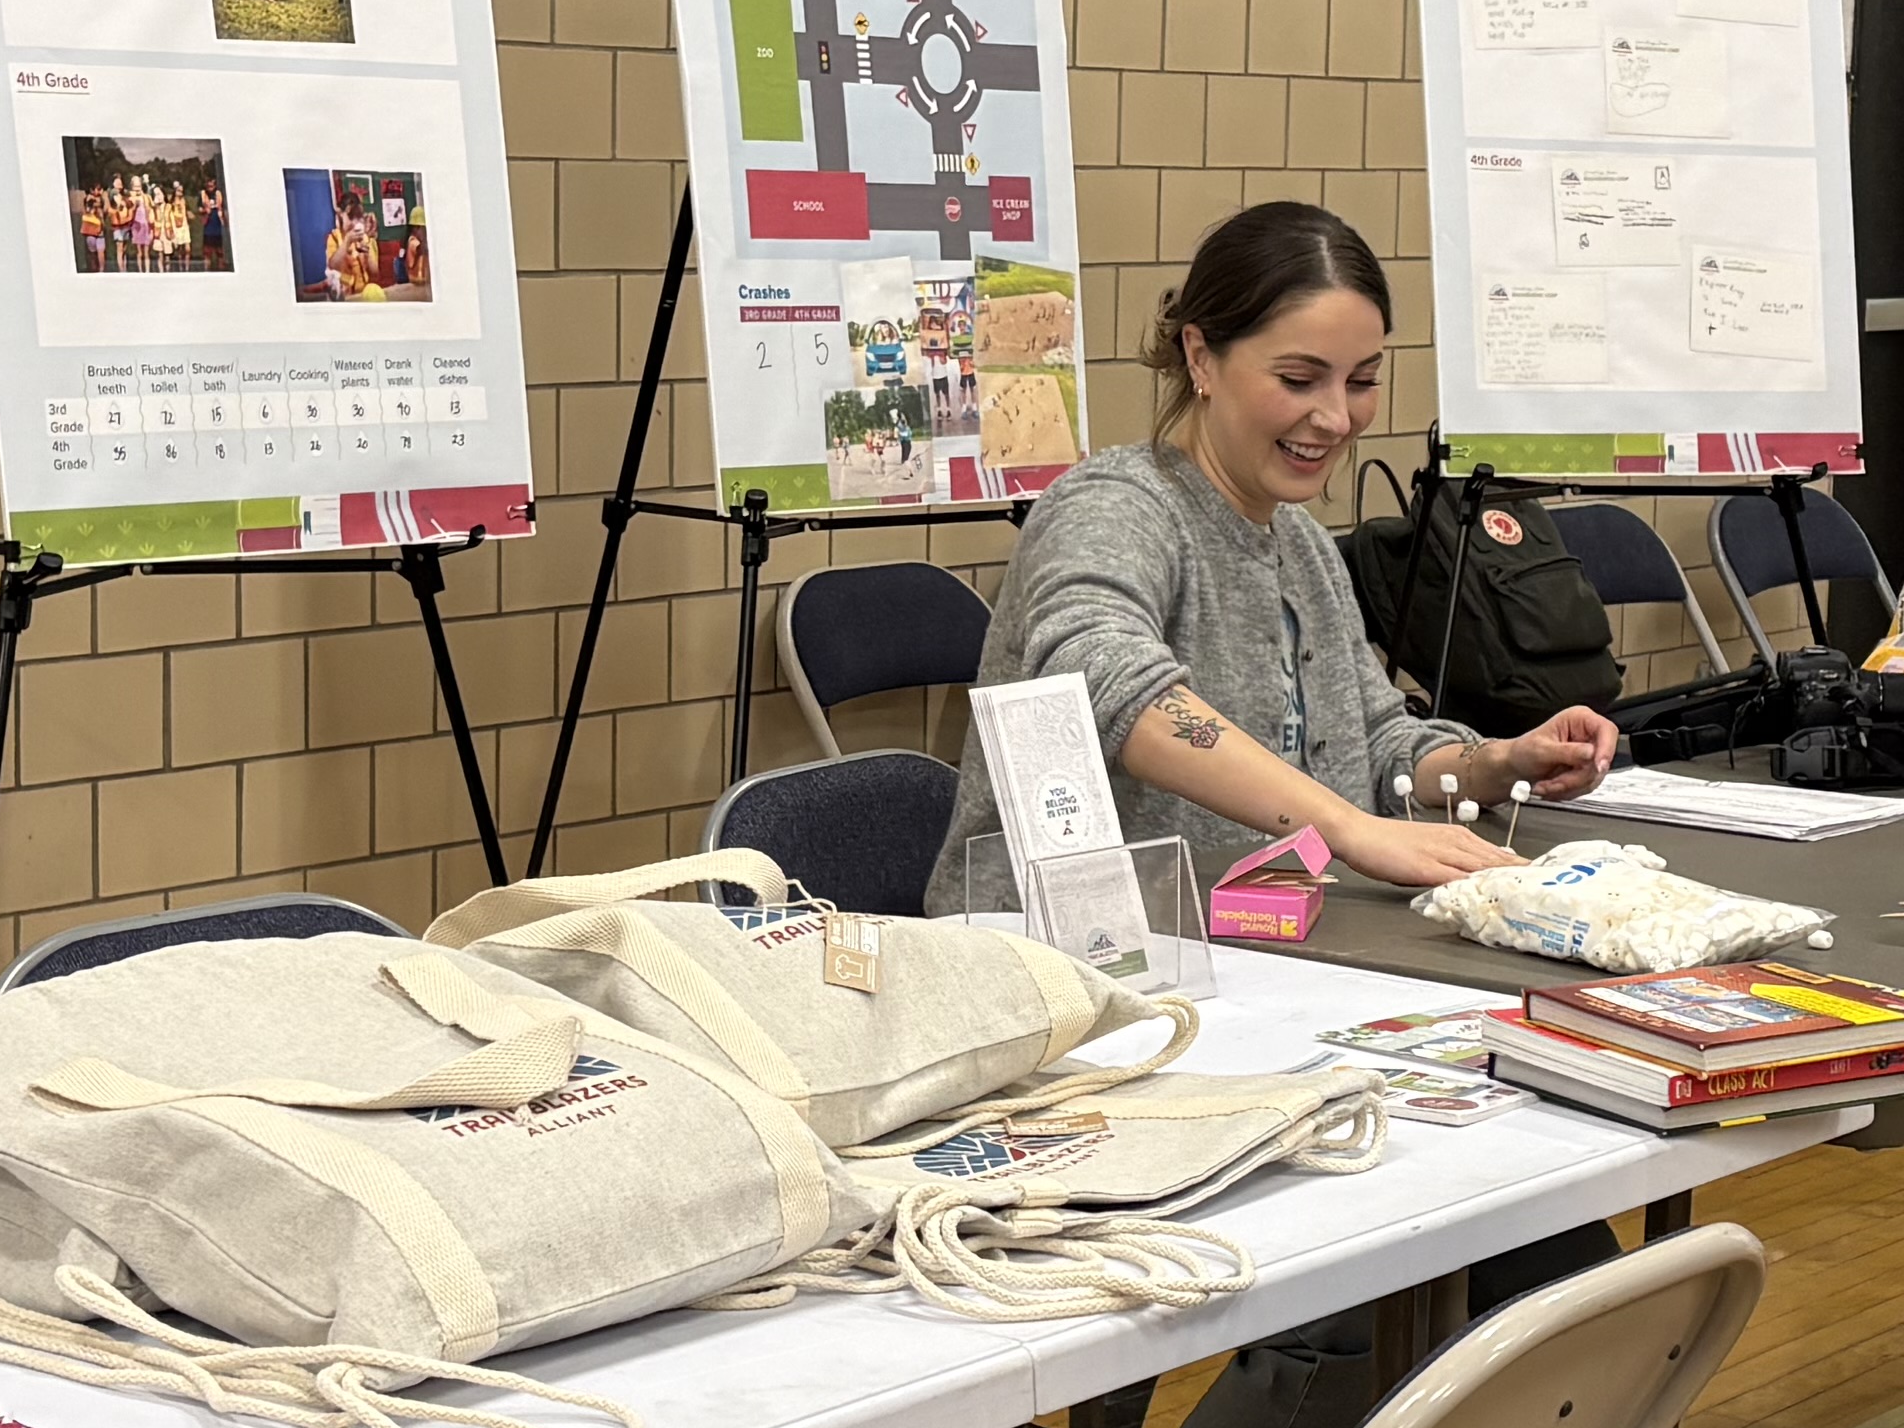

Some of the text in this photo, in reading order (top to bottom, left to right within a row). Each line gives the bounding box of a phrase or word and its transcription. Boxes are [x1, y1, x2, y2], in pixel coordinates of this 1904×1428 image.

[17, 72, 89, 92] 4th Grade
[1470, 155, 1523, 167] 4th Grade
[793, 201, 825, 212] SCHOOL
[738, 284, 791, 300] Crashes
[744, 310, 787, 320] 3RD GRADE
[794, 309, 836, 321] 4TH GRADE
[814, 333, 829, 365] 5
[756, 342, 772, 369] 2
[384, 358, 412, 369] Drank
[87, 365, 133, 378] Brushed
[141, 364, 184, 376] Flushed
[289, 369, 329, 382] Cooking
[242, 371, 282, 383] Laundry
[341, 377, 370, 389] plants
[98, 384, 126, 395] teeth
[151, 382, 178, 393] toilet
[203, 381, 226, 392] bath
[48, 403, 67, 415] 3rd
[108, 412, 121, 425] 27
[50, 421, 84, 433] Grade
[52, 441, 70, 452] 4th
[53, 459, 88, 471] Grade
[1708, 1068, 1778, 1096] CLASS ACT
[442, 1072, 648, 1140] TRAIBLAZERS
[526, 1103, 617, 1138] ALLIANT
